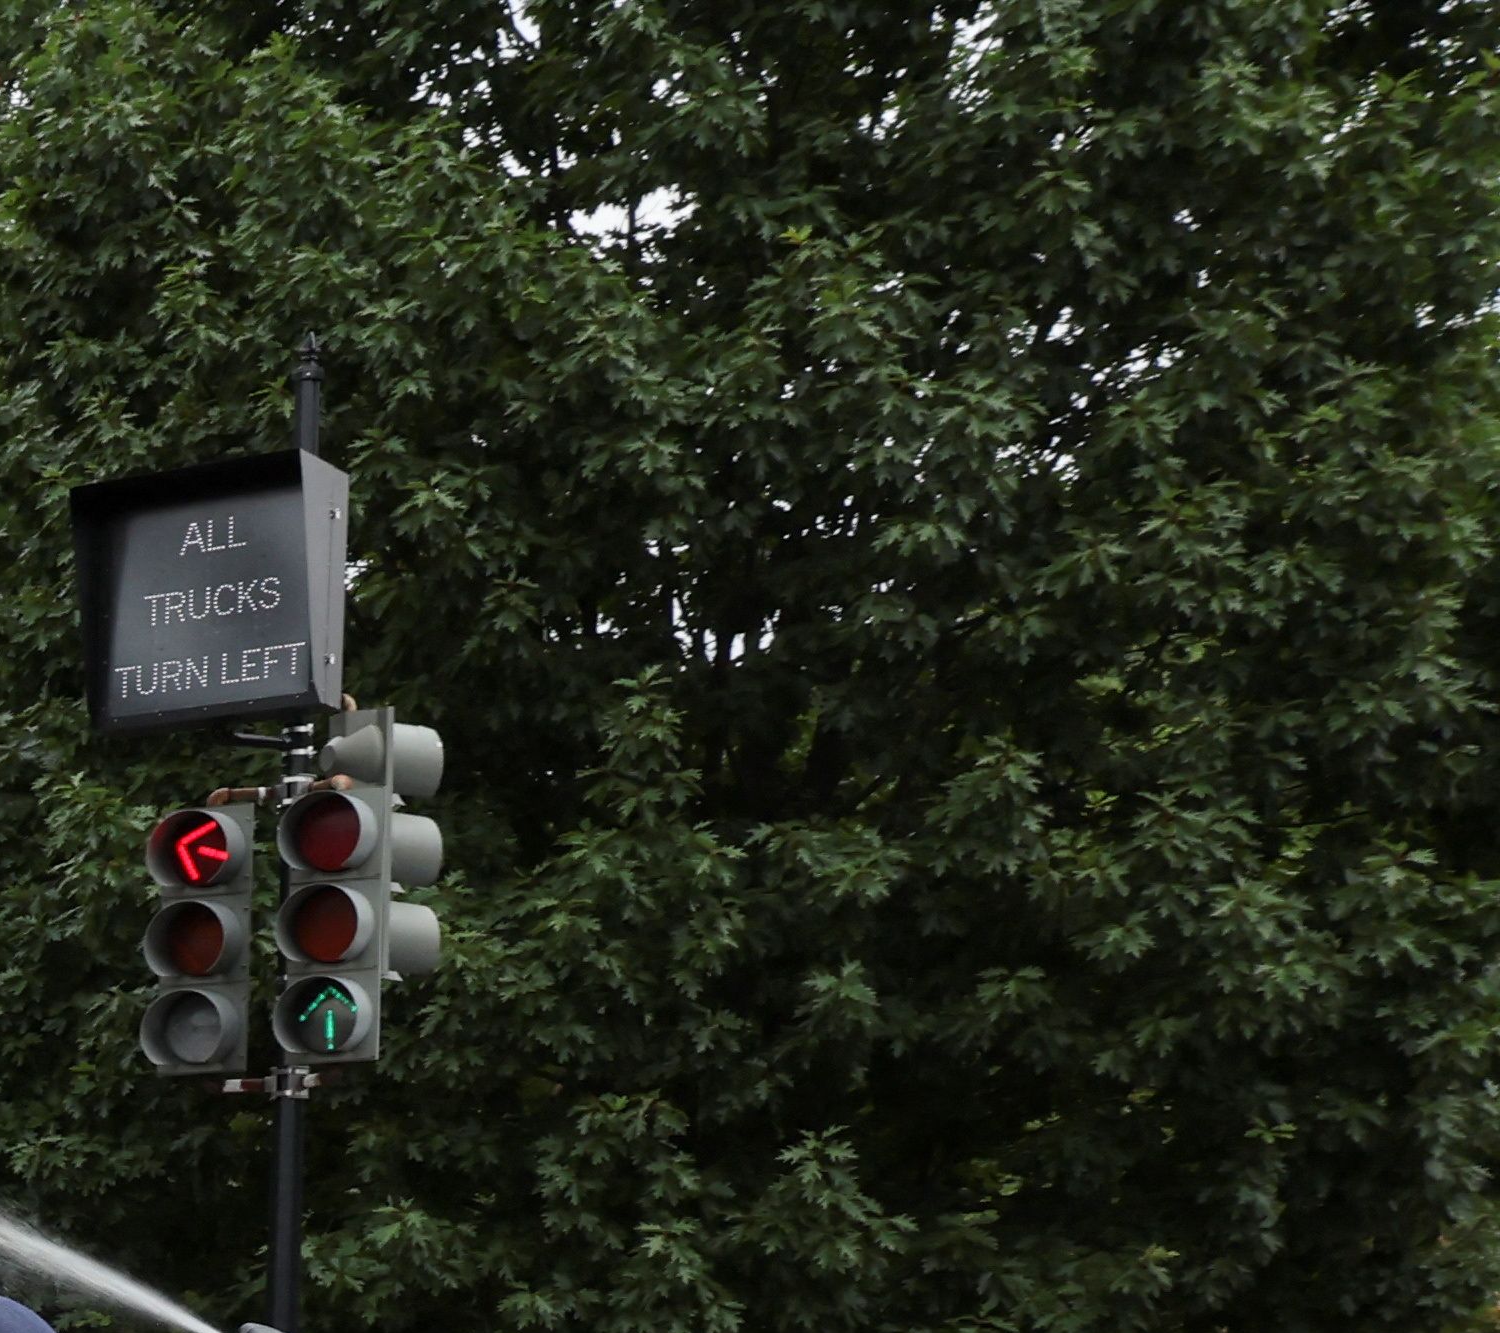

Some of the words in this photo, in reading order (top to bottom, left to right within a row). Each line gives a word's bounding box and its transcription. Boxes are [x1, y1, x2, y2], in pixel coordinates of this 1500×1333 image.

[179, 515, 248, 556] ALL
[143, 576, 281, 627] TRUCKS
[114, 655, 210, 699] TURN
[220, 641, 307, 685] LEFT
